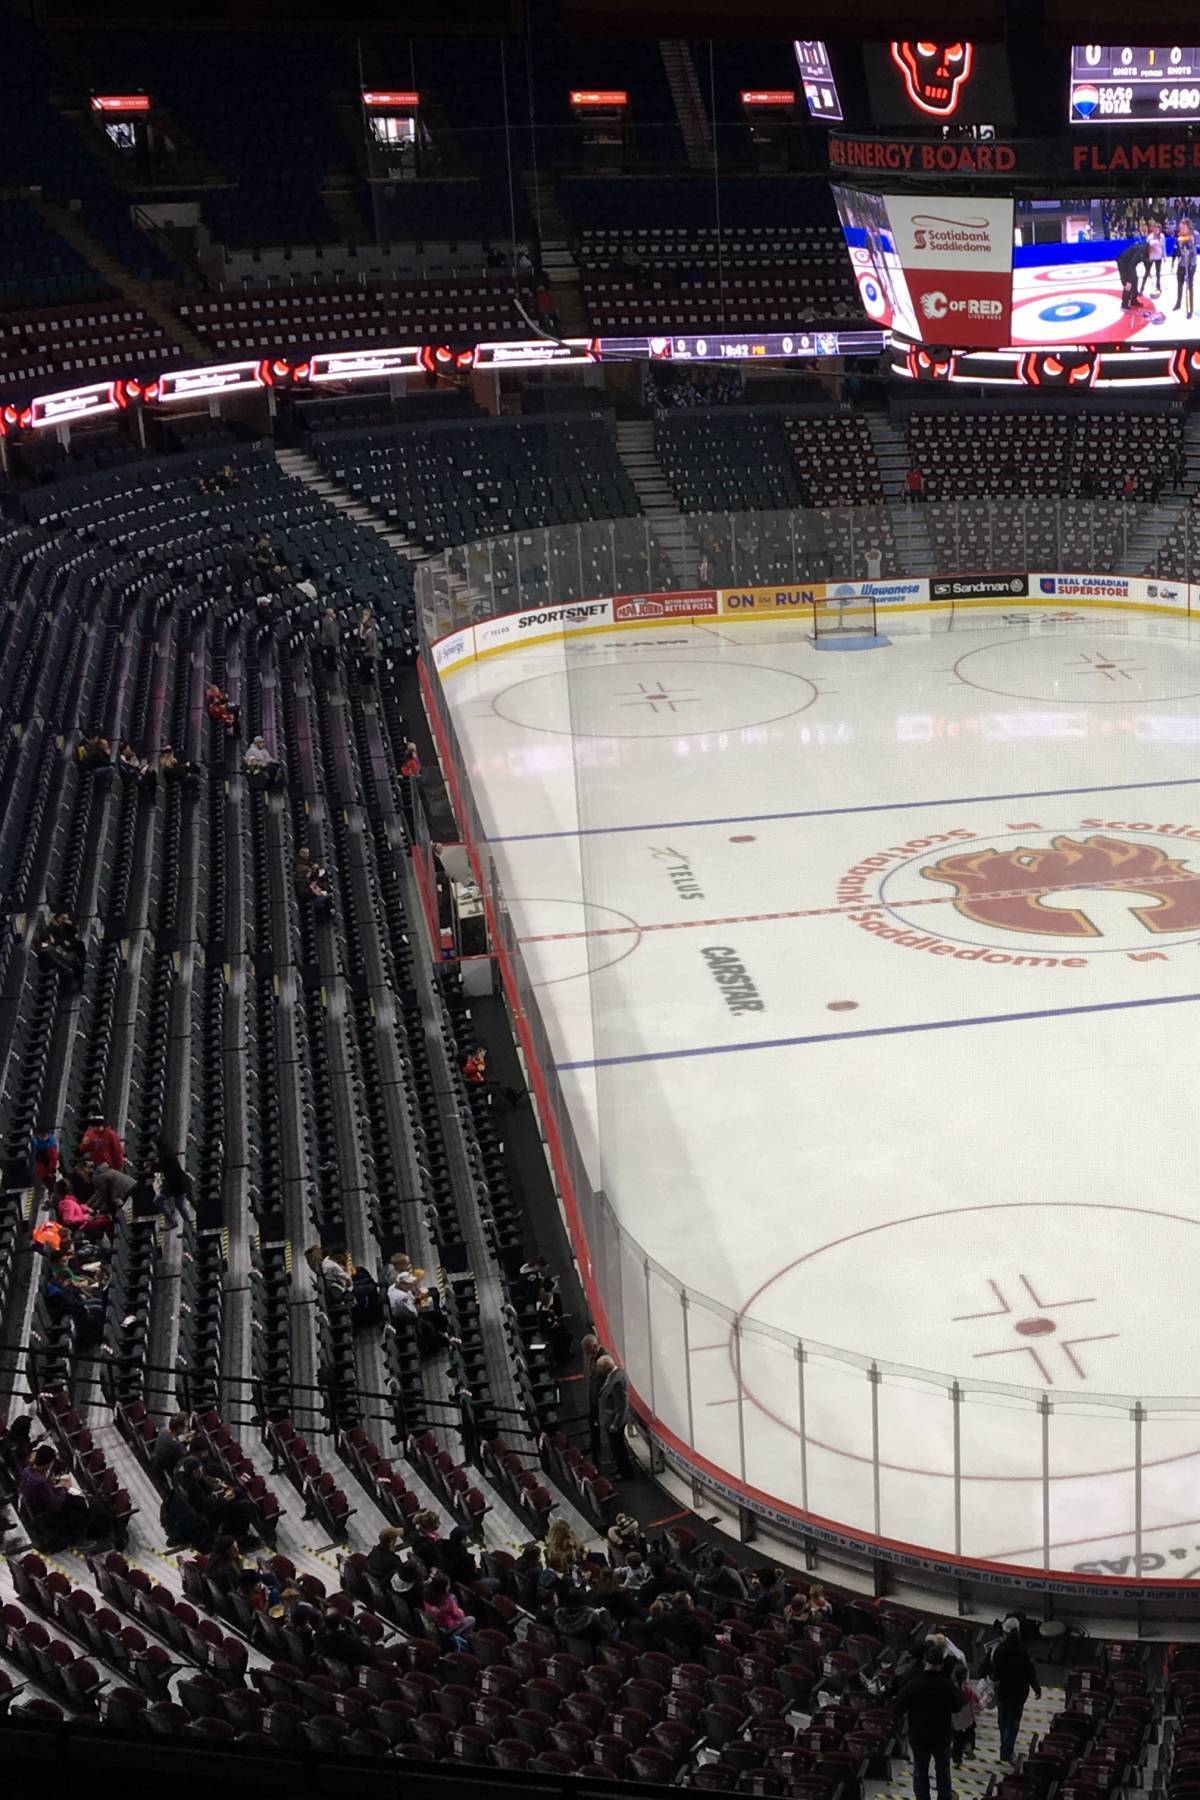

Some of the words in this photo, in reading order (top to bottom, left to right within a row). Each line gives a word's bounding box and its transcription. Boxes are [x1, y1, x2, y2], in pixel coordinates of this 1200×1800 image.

[1113, 67, 1138, 77] SHOTS
[1167, 66, 1192, 76] SHOTS
[1099, 87, 1133, 101] 50/50
[1158, 89, 1200, 111] $480
[1099, 100, 1132, 114] TOTAL
[847, 141, 914, 169] ENERGY
[921, 145, 1016, 172] BOARD
[1073, 144, 1186, 172] FLAMES
[928, 229, 990, 242] Scotiabank
[930, 241, 992, 252] Saddledome
[950, 301, 966, 312] OF
[968, 299, 1003, 314] RED
[952, 582, 1010, 594] Sandman
[1057, 577, 1079, 586] REAL
[1080, 578, 1129, 587] CANADIAN
[860, 584, 920, 596] Wawanesa
[1057, 585, 1129, 597] SUPERSTORE
[727, 590, 755, 609] ON
[775, 589, 816, 606] RUN
[517, 603, 609, 629] SPORTSNET
[836, 828, 977, 906] Scotiabank
[666, 863, 705, 901] TELUS
[847, 910, 1089, 970] Saddledome
[1073, 1552, 1167, 1576] GAS
